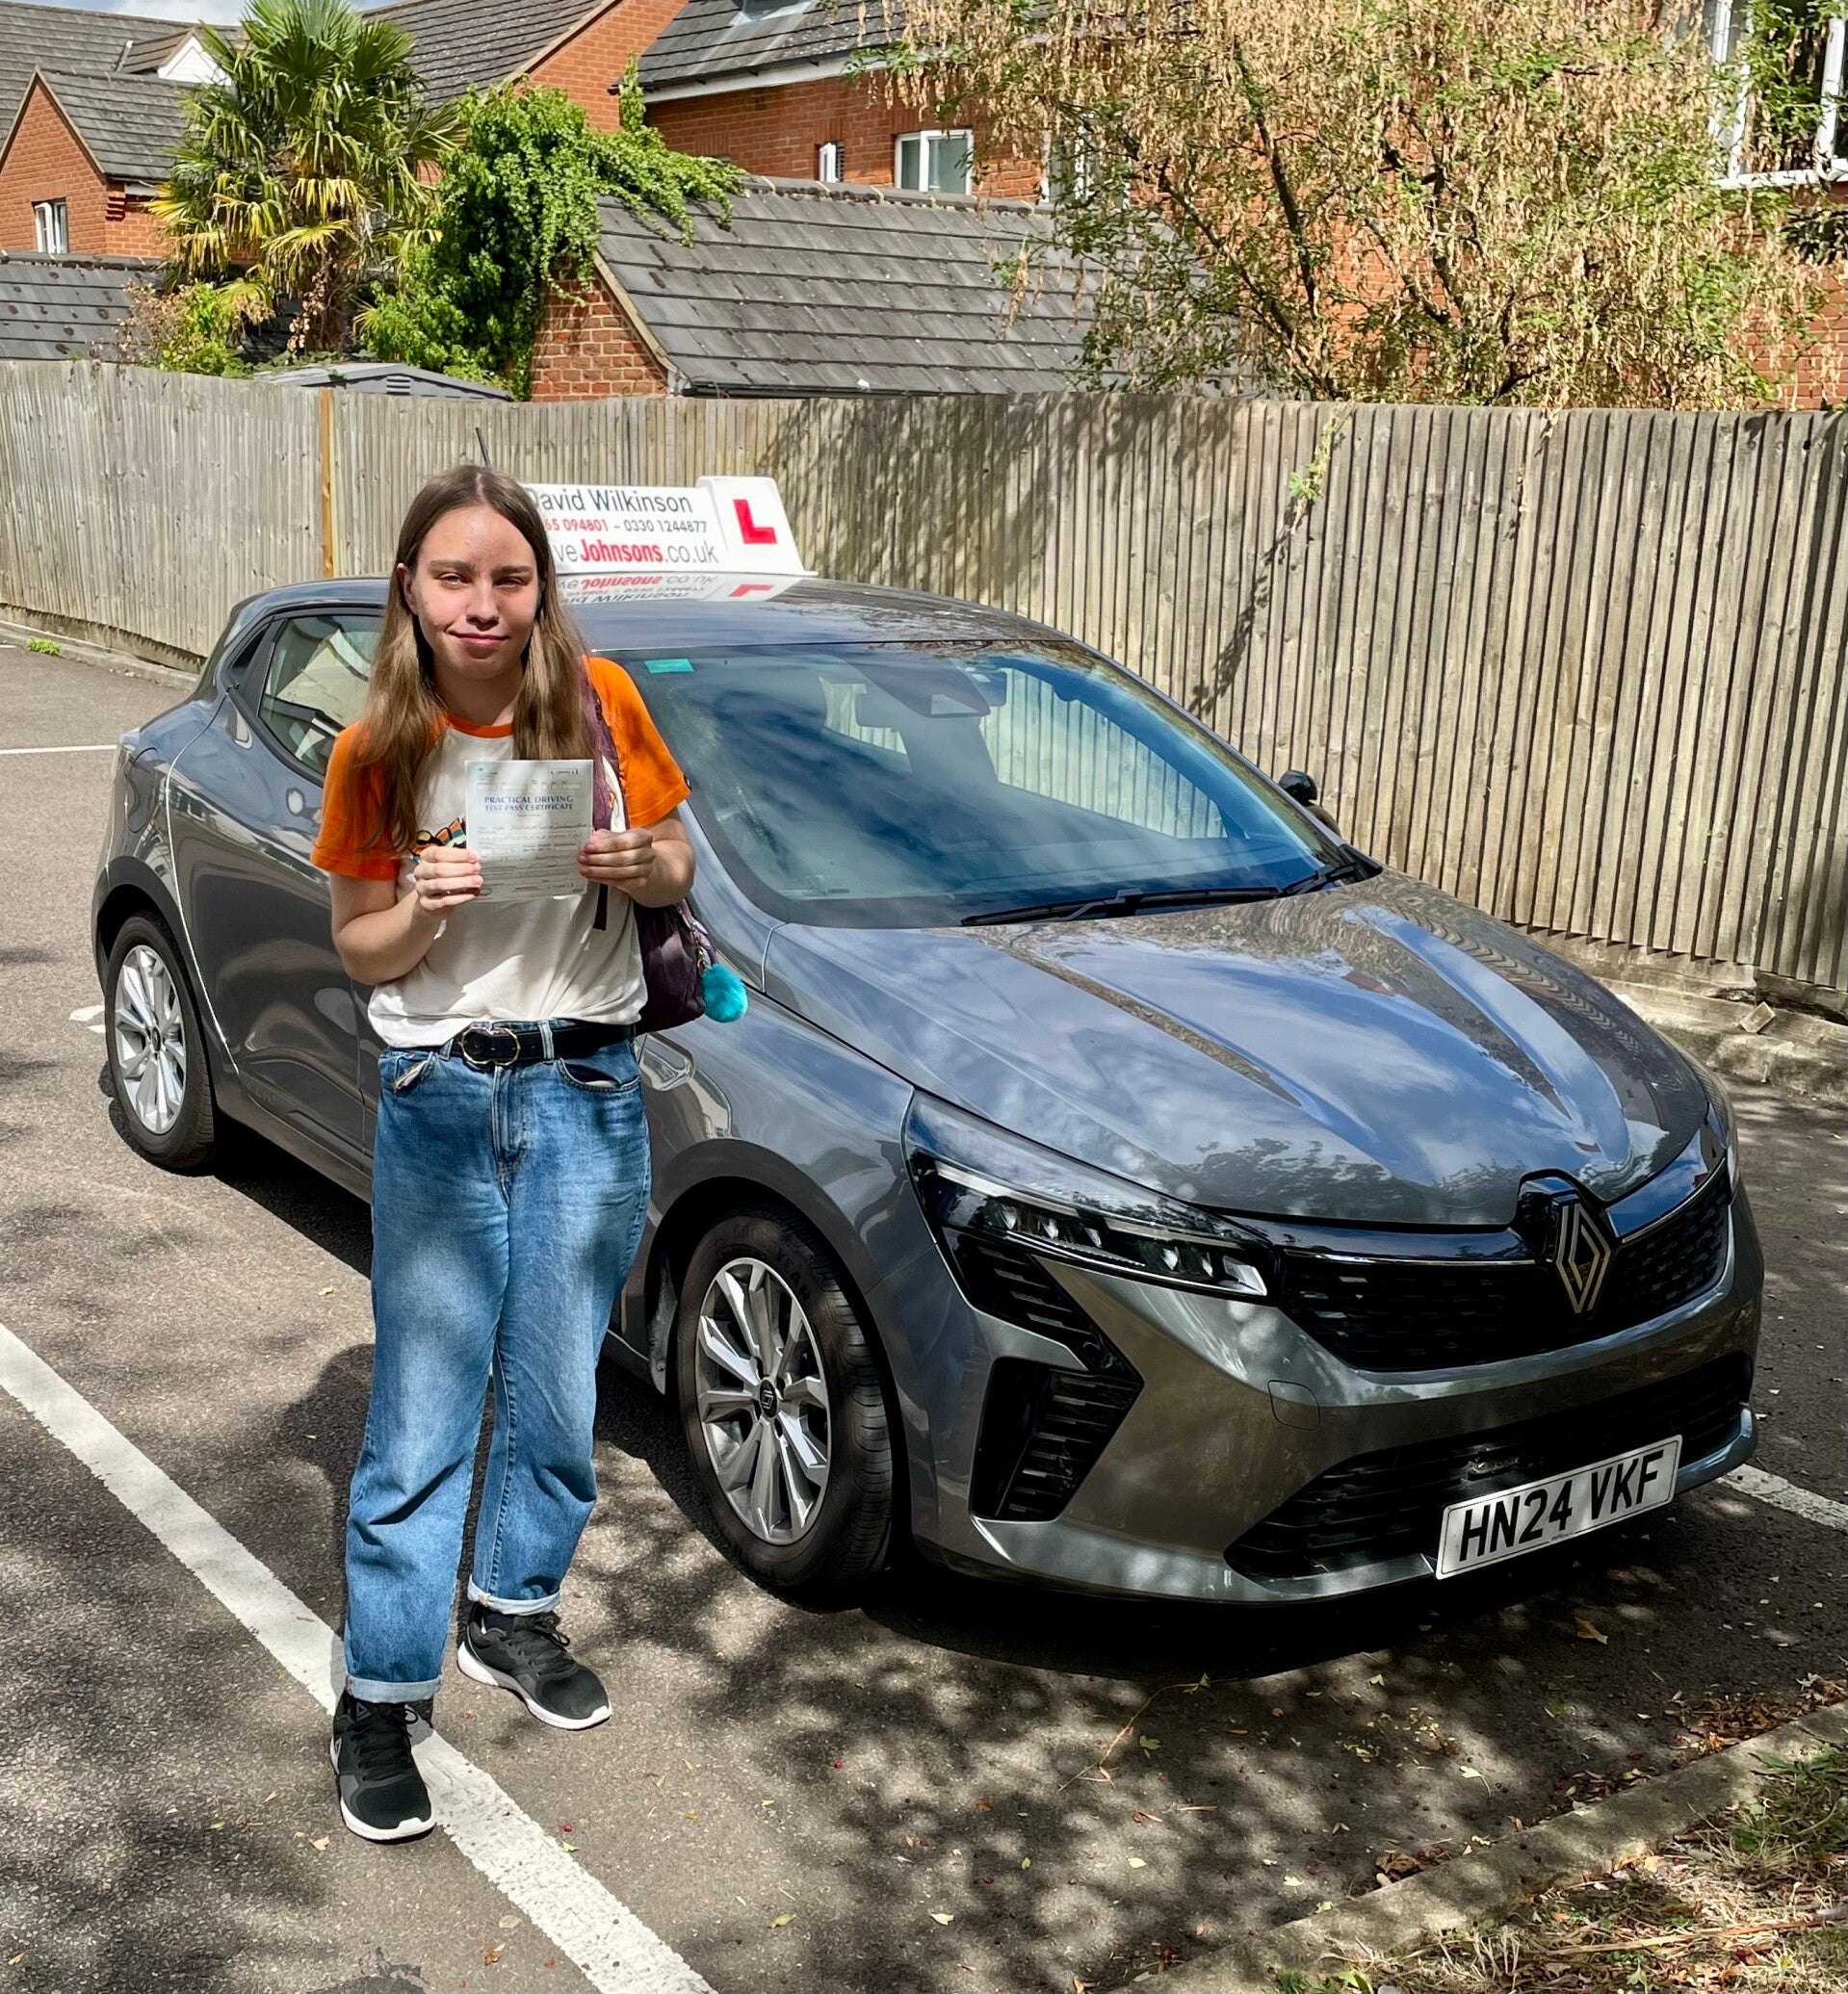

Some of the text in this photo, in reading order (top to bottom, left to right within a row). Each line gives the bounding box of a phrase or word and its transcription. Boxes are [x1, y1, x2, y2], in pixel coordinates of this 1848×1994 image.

[589, 489, 692, 513] Wilkinson
[563, 518, 609, 532] 094801
[624, 520, 655, 532] 0330
[658, 521, 707, 533] 1244877
[733, 499, 778, 544] L
[553, 539, 718, 563] veJohnsons.co.uk
[1459, 1449, 1664, 1562] HN24 VKF
